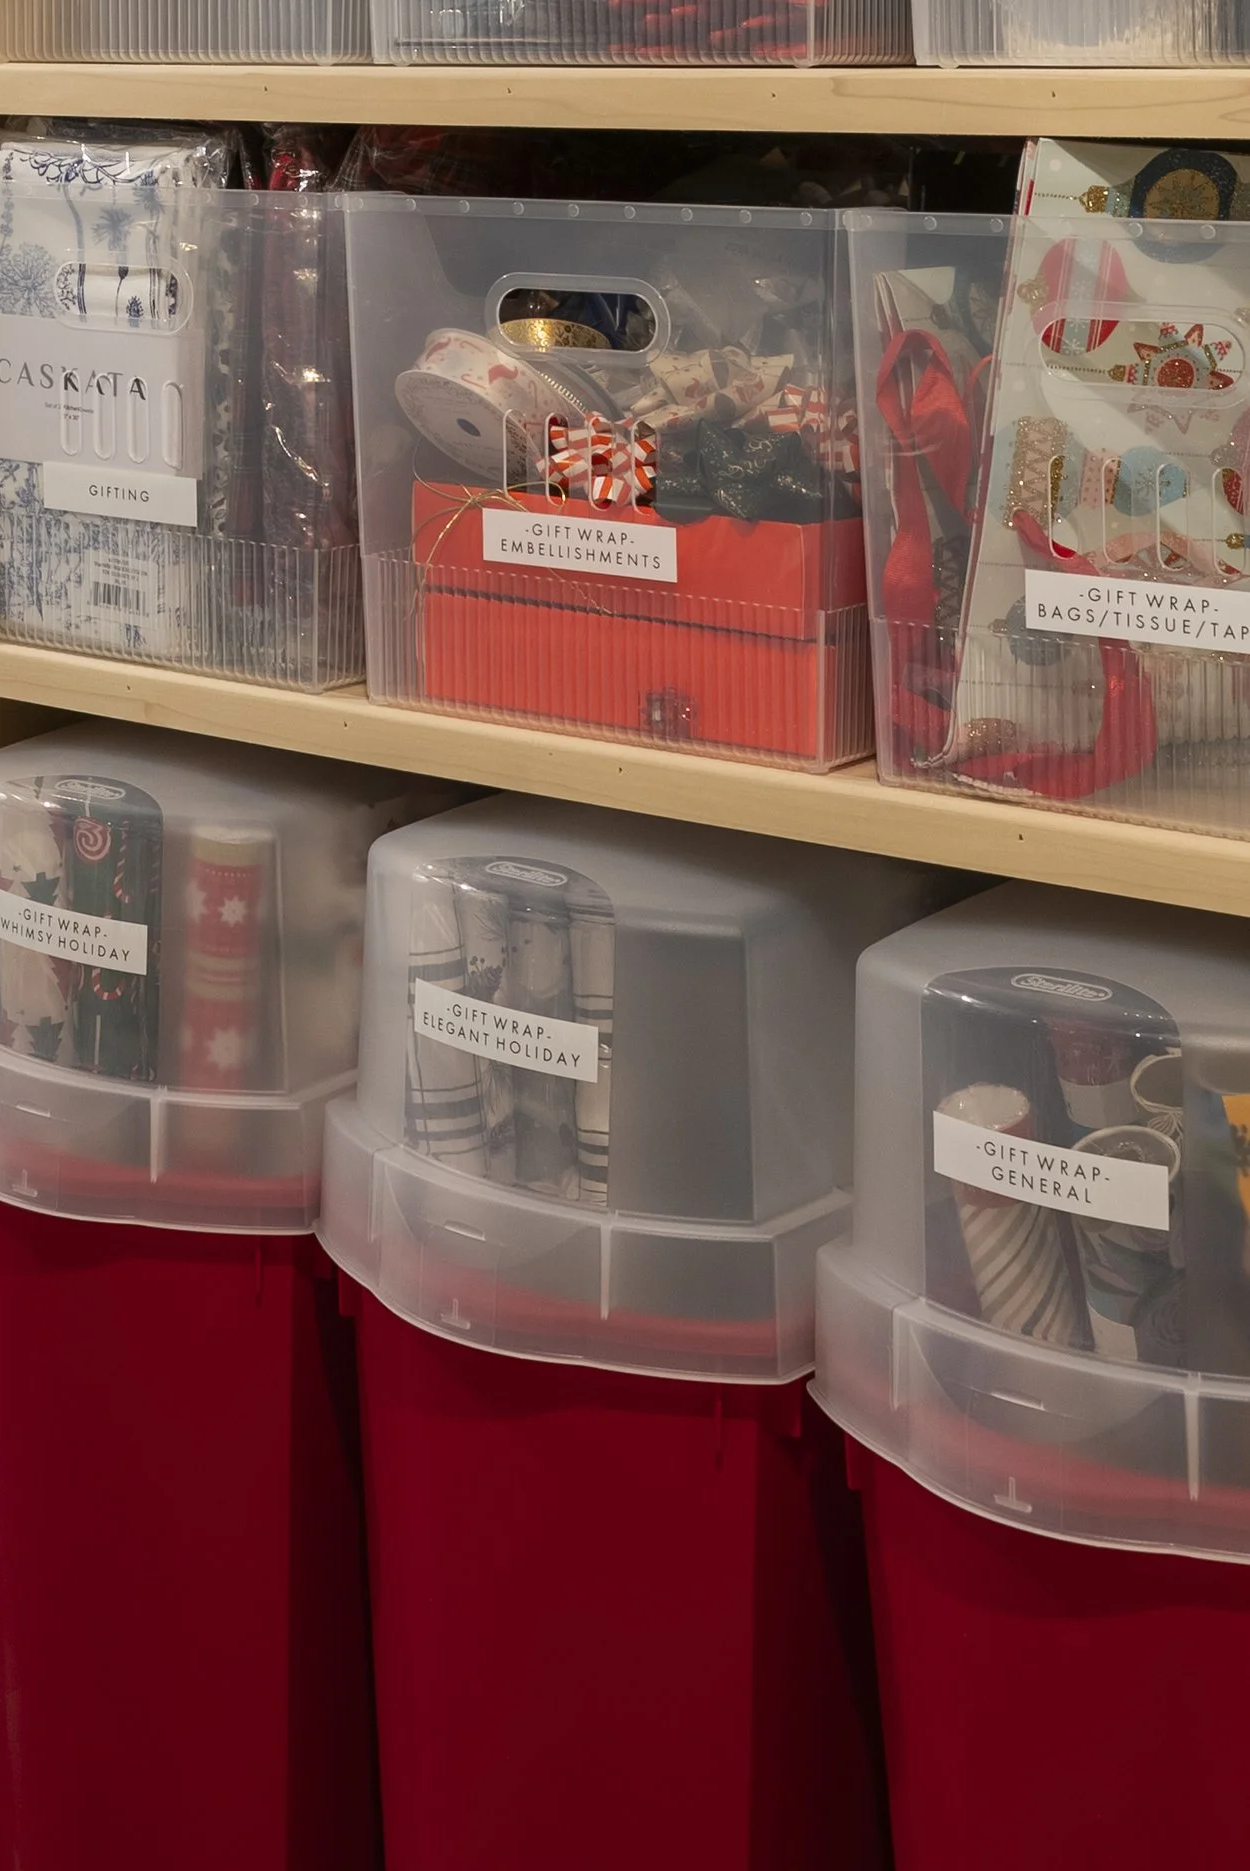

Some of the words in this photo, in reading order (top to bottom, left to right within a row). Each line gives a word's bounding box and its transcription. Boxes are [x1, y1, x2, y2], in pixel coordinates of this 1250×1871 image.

[89, 484, 149, 502] GIFTING
[501, 539, 661, 569] EMBELLISHMENTS
[0, 917, 53, 944] WHIMSY
[58, 936, 130, 961] HOLIDAY
[423, 1012, 490, 1046] ELEGANT
[496, 1037, 581, 1067] HOLIDAY
[992, 1166, 1092, 1204] GENERAL
